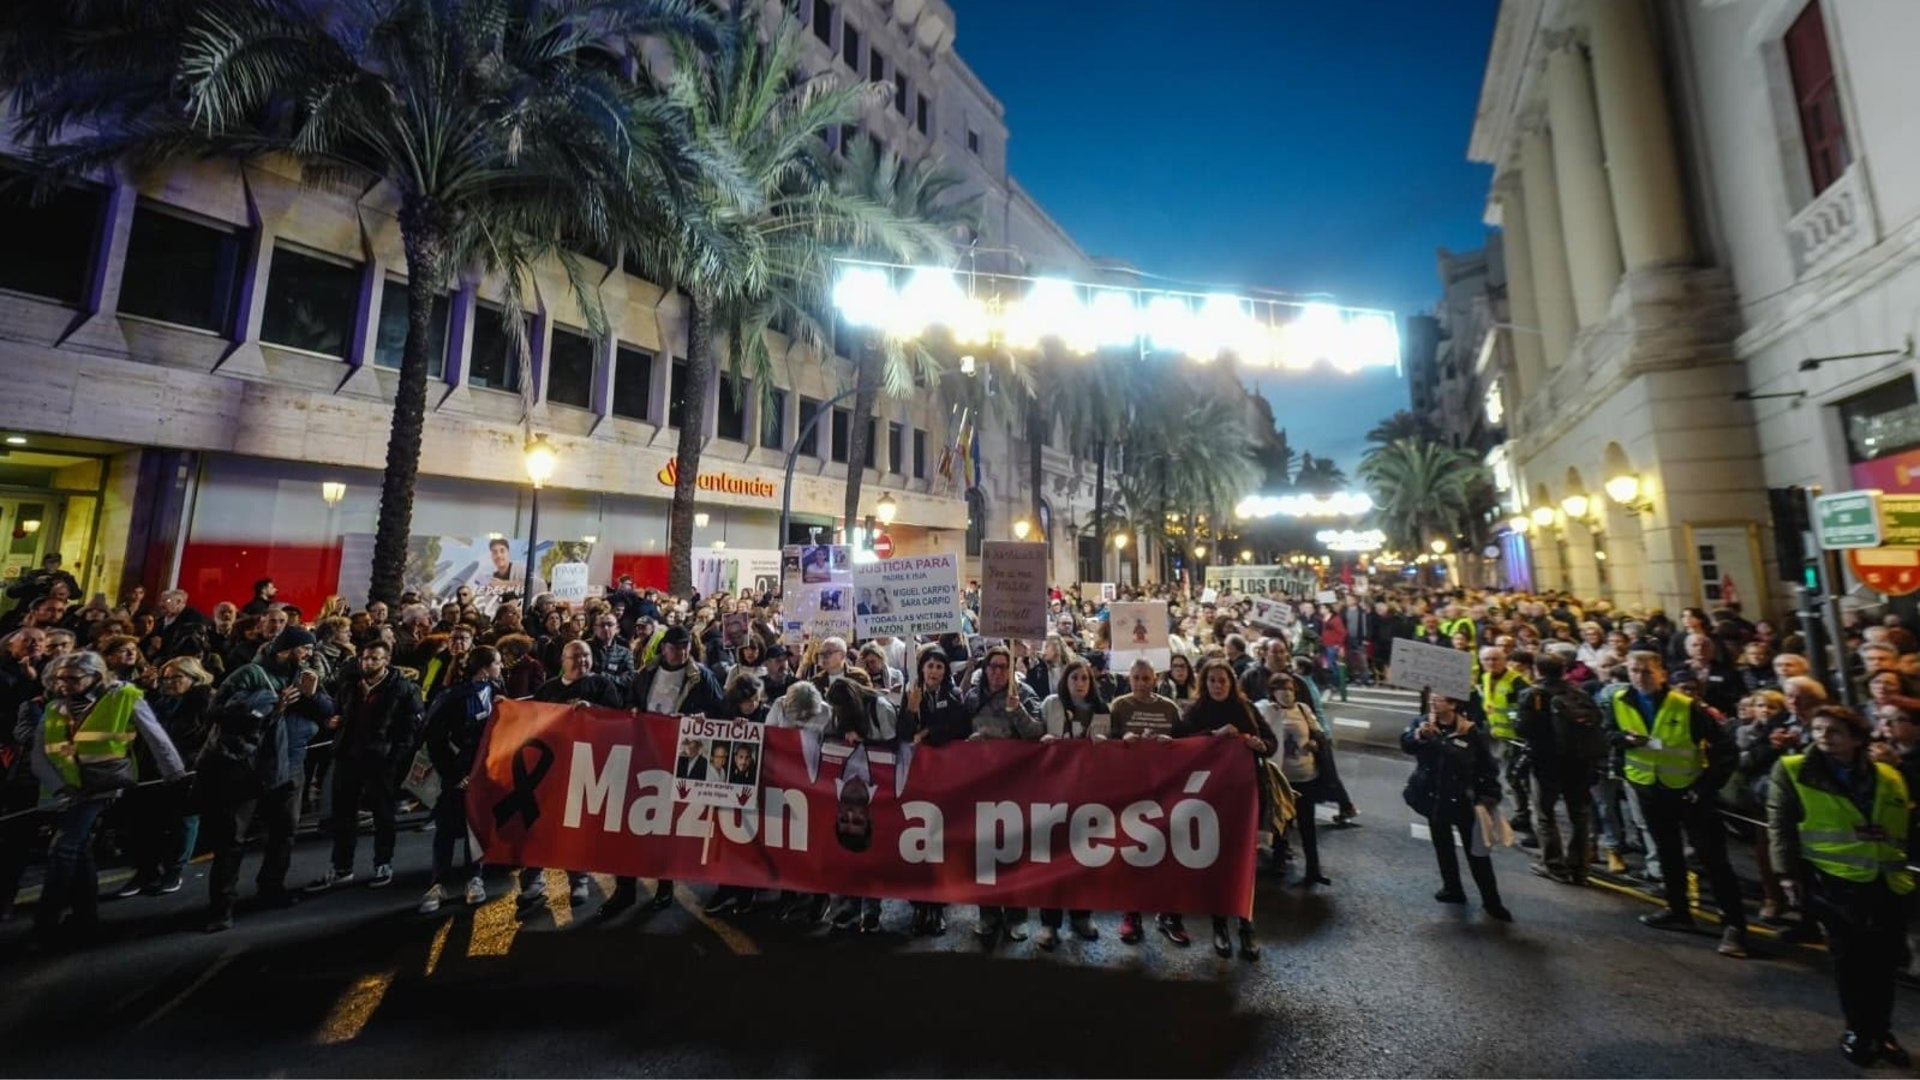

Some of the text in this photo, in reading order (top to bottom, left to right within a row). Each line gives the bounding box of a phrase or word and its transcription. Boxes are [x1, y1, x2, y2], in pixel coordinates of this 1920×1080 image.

[697, 472, 776, 498] antander
[858, 557, 950, 574] JUSTICIA PARA
[892, 587, 919, 597] MIGUEL
[951, 584, 957, 592] Y
[901, 598, 921, 608] SARA
[871, 615, 897, 624] TODAS
[899, 613, 914, 622] LAS
[682, 720, 760, 740] JUSTICIA
[899, 800, 944, 864] a
[976, 770, 1220, 885] presó
